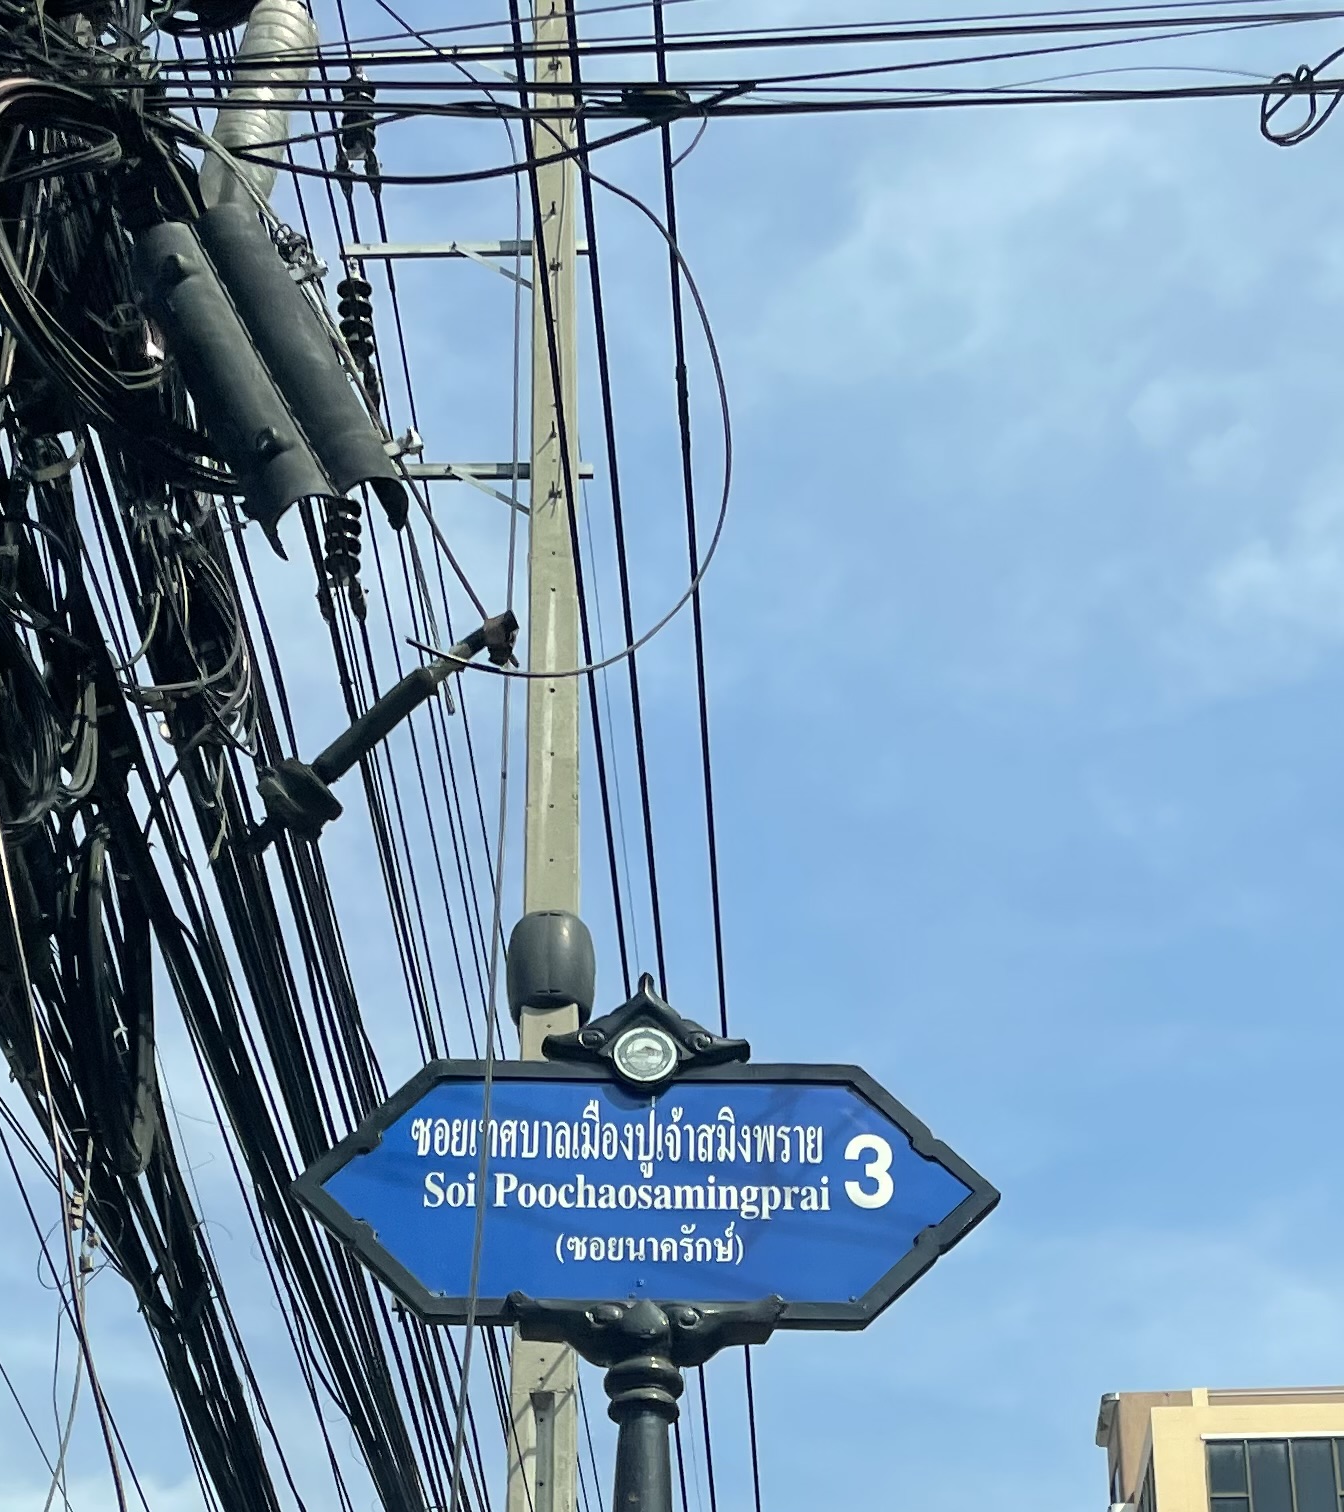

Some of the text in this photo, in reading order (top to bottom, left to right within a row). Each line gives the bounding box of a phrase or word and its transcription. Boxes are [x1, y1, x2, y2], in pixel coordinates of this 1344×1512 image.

[423, 1134, 895, 1220] Soi Poochaosamingprai 3
[555, 1221, 744, 1265] (ซอยนาครักษ์)
